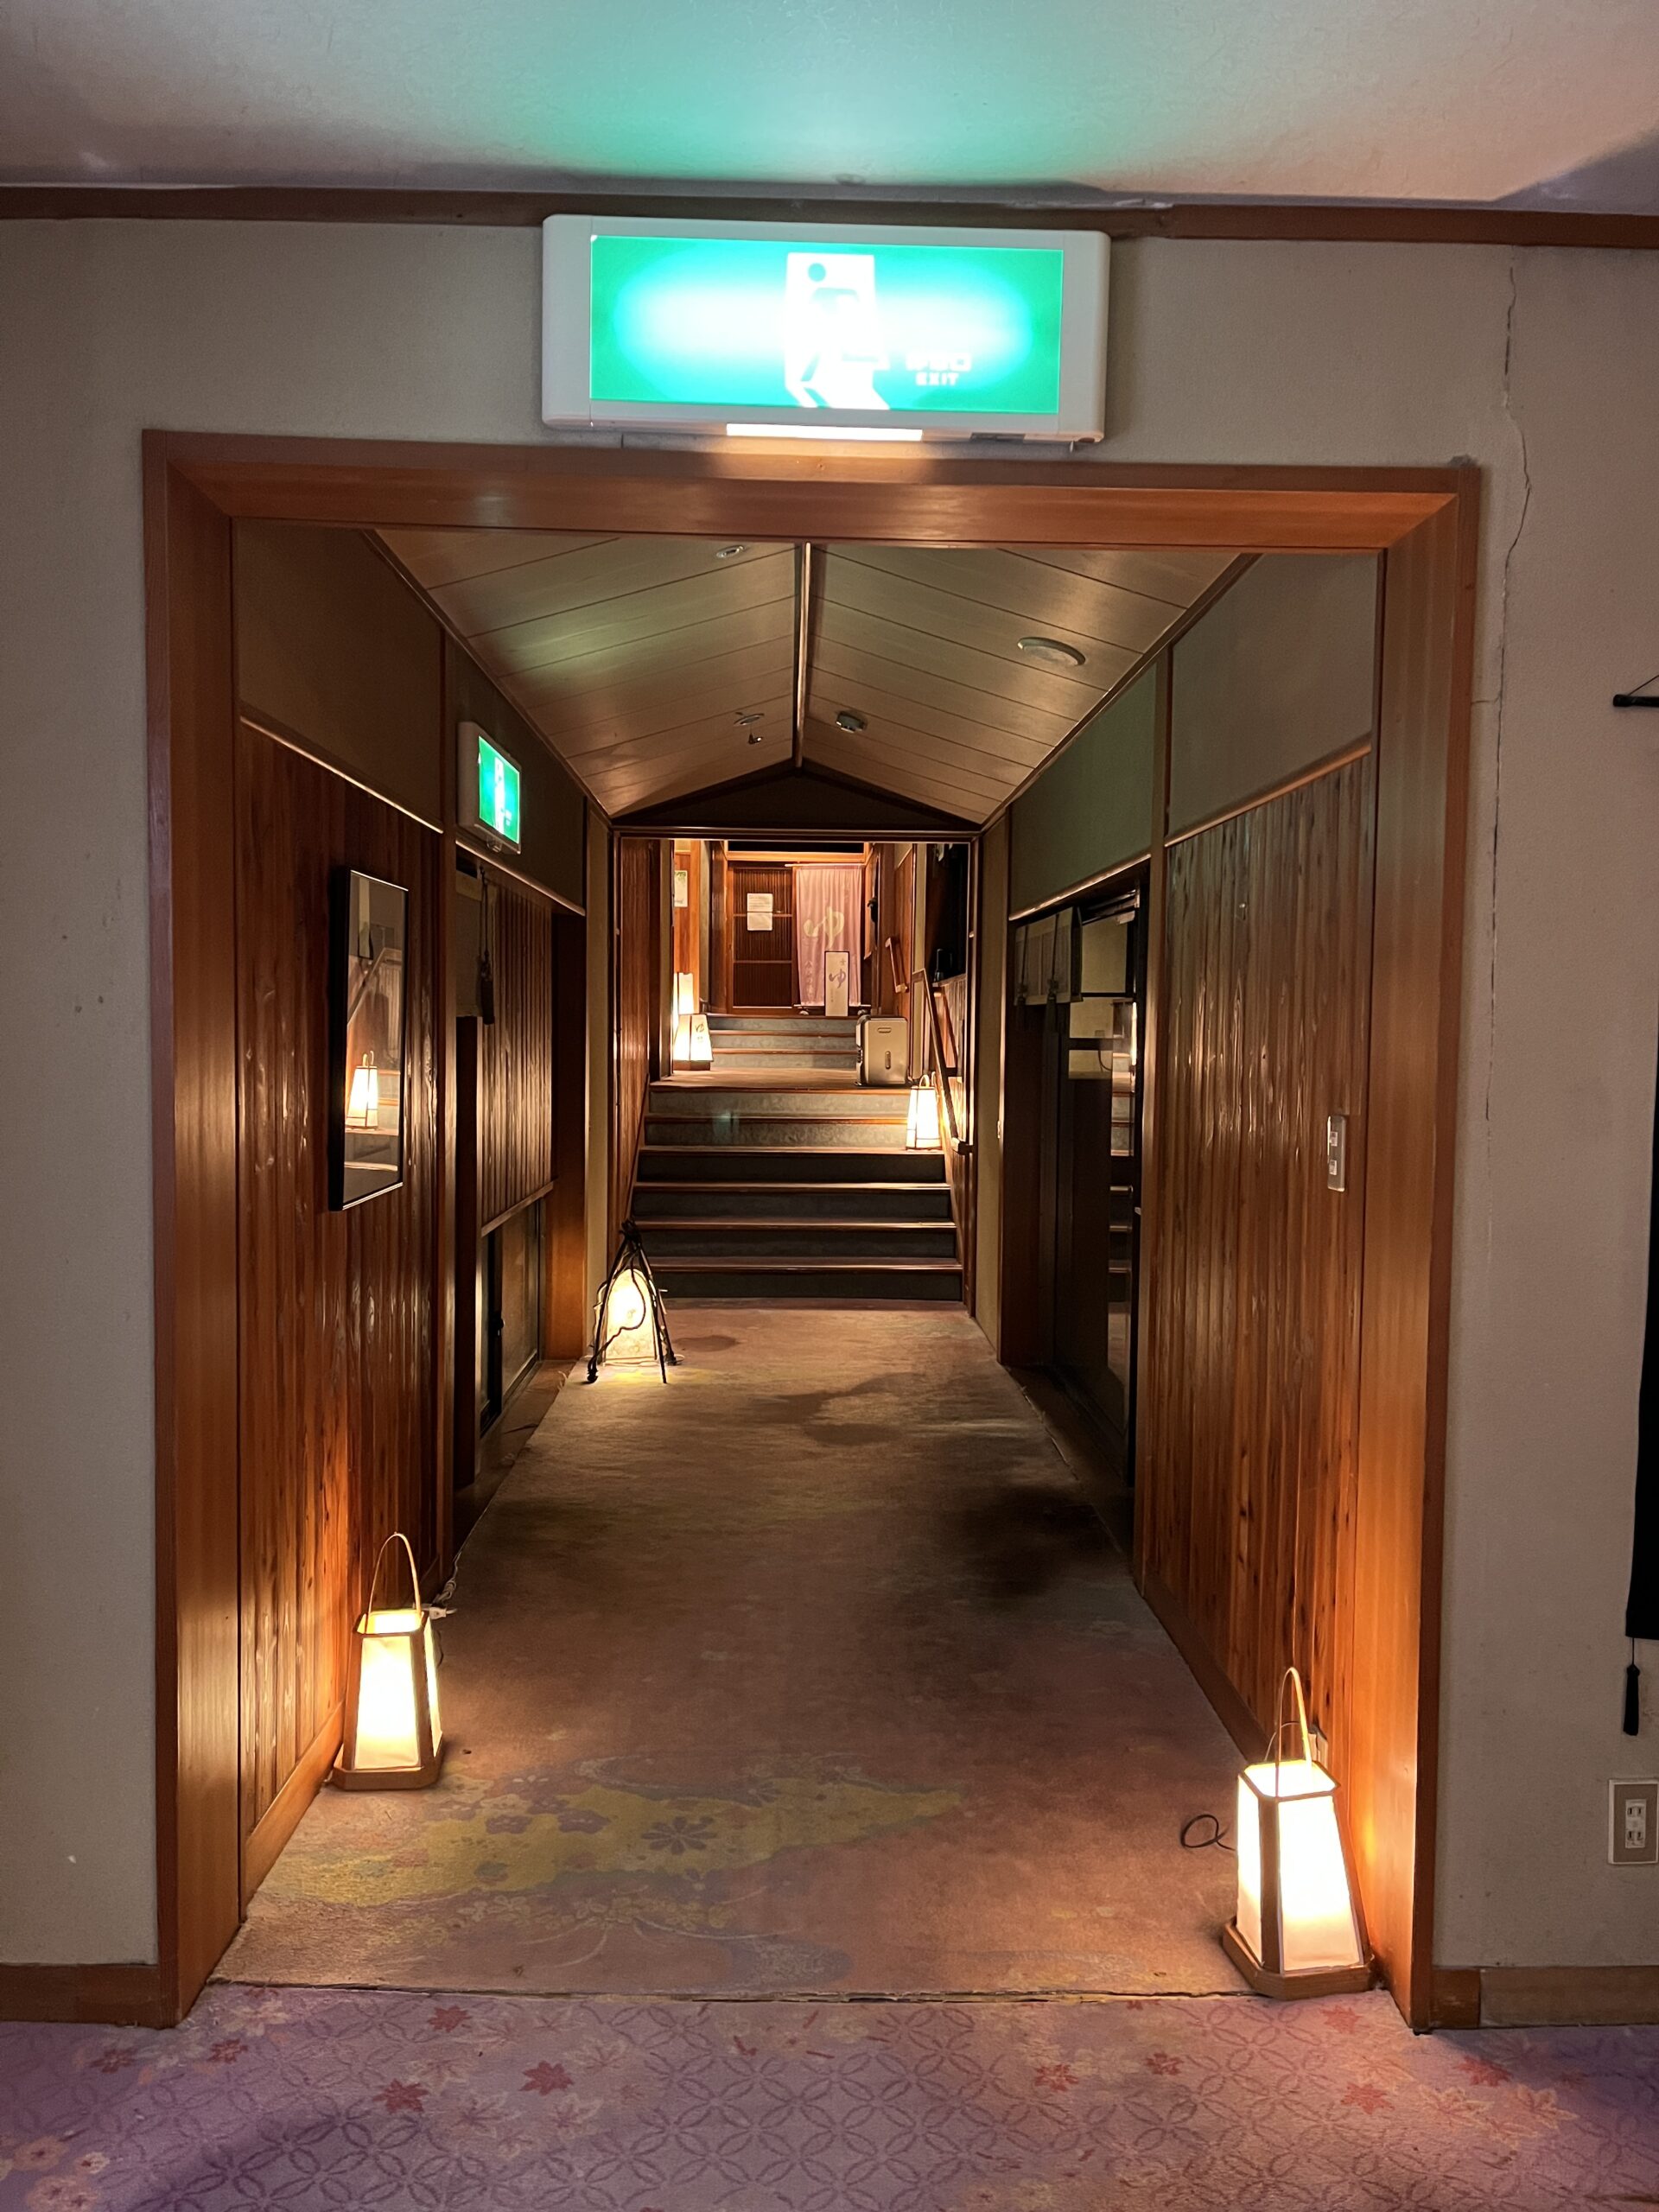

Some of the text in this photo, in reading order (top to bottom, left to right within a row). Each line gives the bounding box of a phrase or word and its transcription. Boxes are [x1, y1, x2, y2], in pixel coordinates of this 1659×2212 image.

[915, 372, 960, 386] EXIT
[803, 906, 844, 950] ゆ
[828, 968, 847, 989] ゆ
